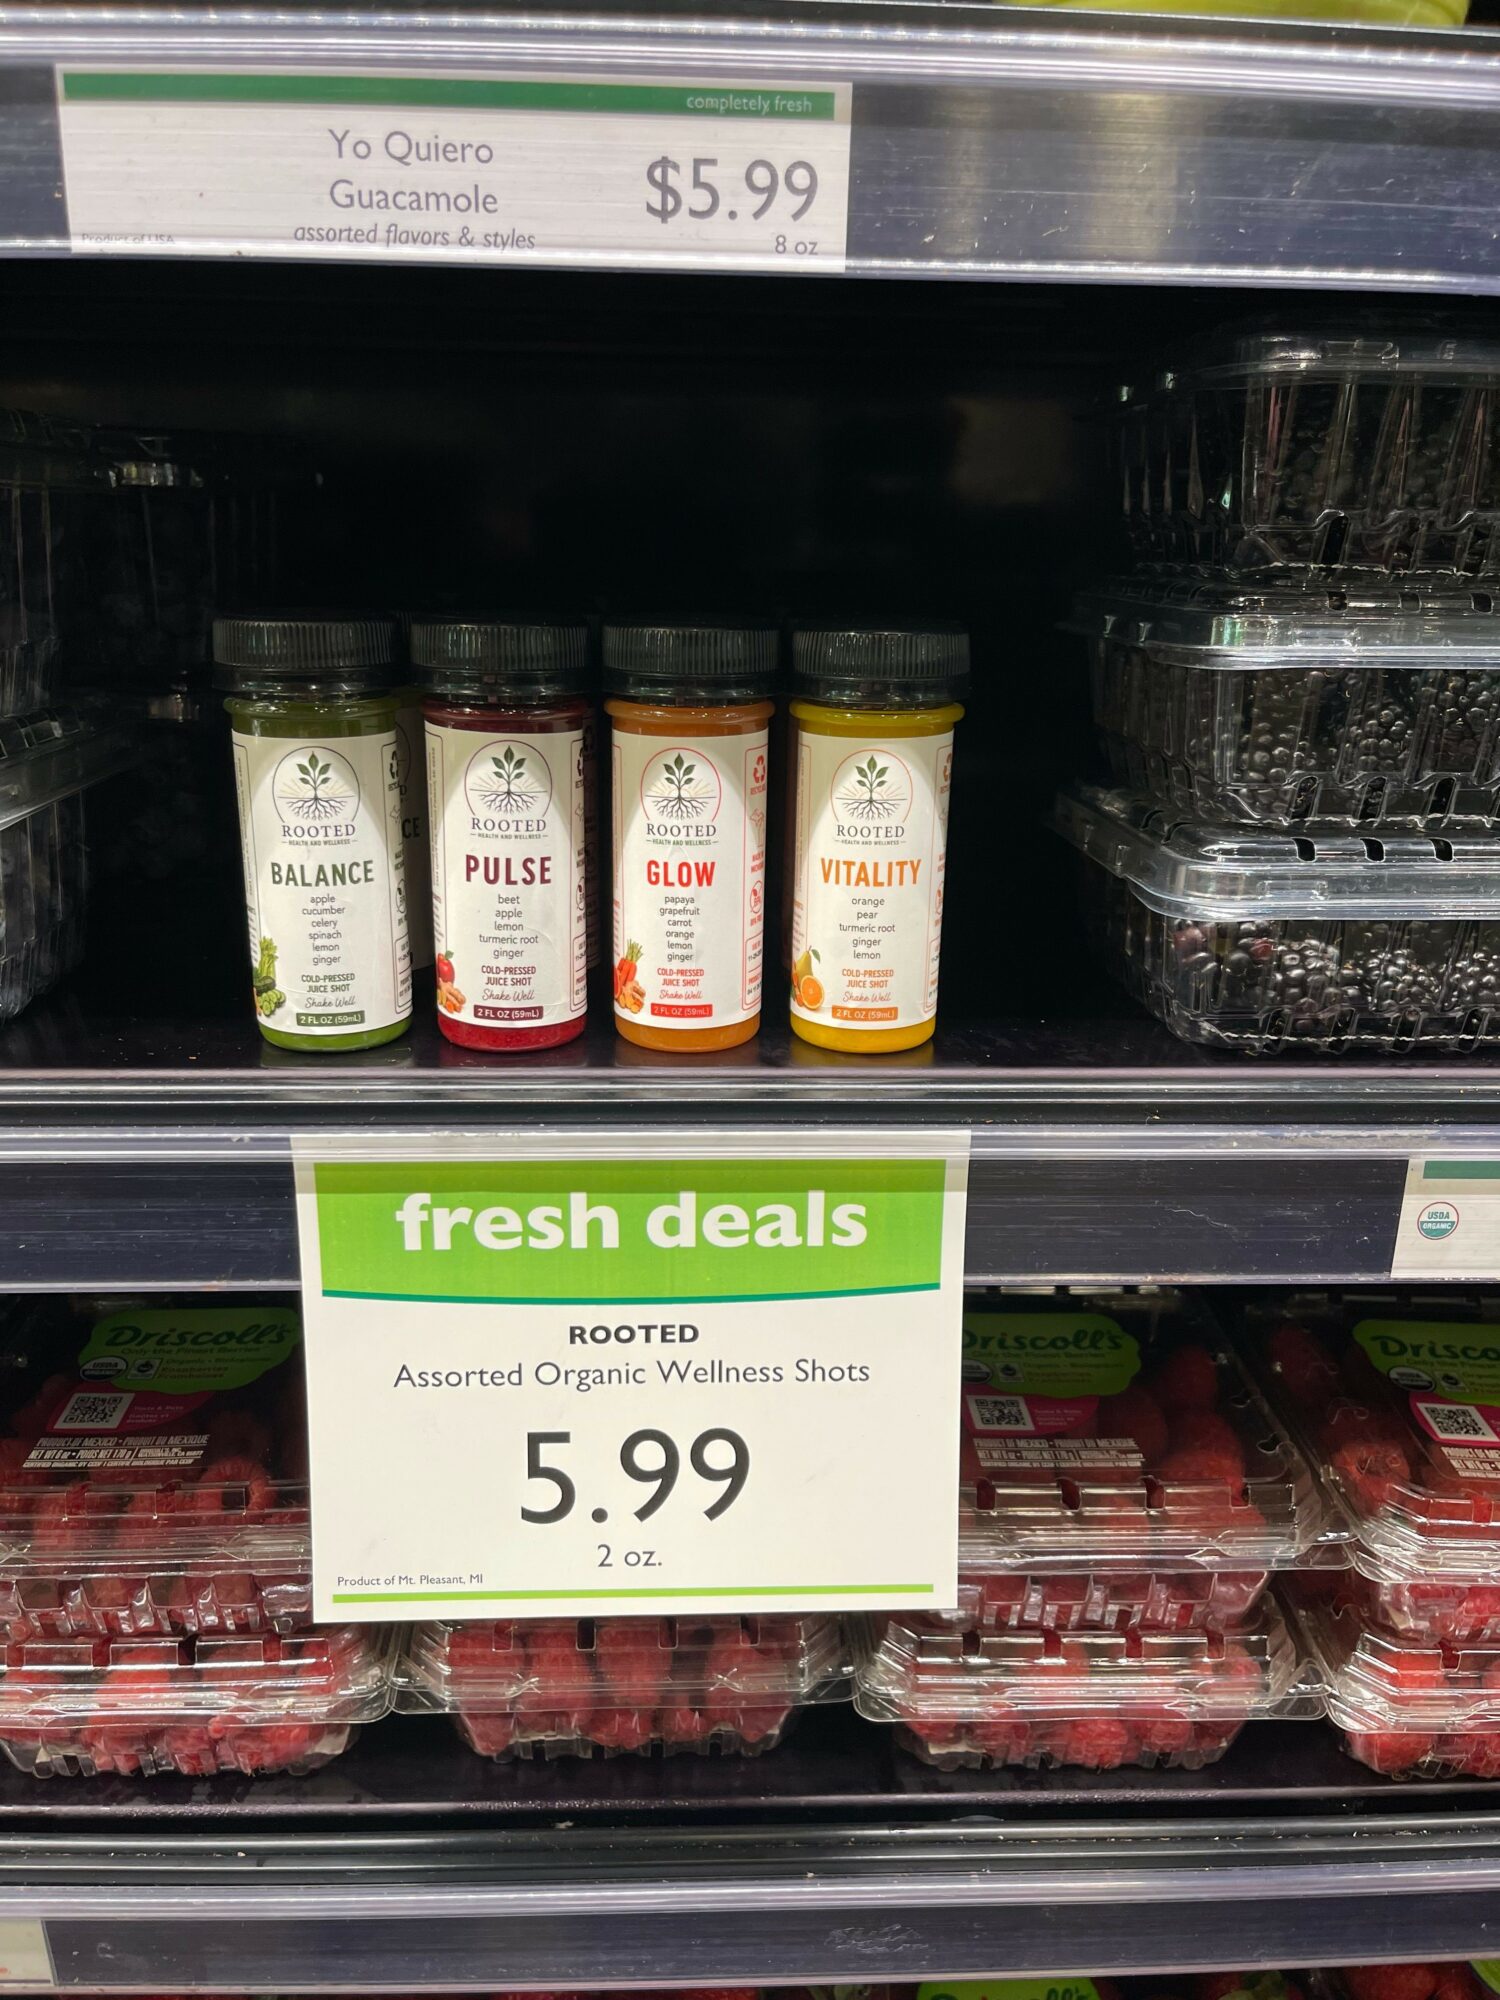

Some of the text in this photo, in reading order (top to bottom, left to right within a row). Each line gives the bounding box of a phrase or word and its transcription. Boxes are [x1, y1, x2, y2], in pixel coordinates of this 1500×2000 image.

[686, 95, 812, 114] completely fresh
[328, 129, 493, 166] Yo Quiero
[646, 155, 819, 223] $5.99
[330, 179, 498, 213] Guacamole
[294, 223, 536, 252] assorted flavors & styles
[774, 235, 819, 256] 8 oz
[471, 817, 547, 832] ROOTED
[646, 823, 717, 837] ROOTED
[281, 824, 356, 838] ROOTED
[836, 824, 905, 838] ROOTED
[310, 839, 321, 847] AND
[323, 838, 351, 846] WELLNESS
[652, 838, 671, 846] HEALTH
[270, 859, 375, 887] BALANCE
[465, 854, 552, 885] PULSE
[647, 859, 716, 888] GLOW
[820, 857, 922, 887] VITALITY
[310, 893, 336, 906] apple
[498, 893, 520, 905] beet
[664, 896, 695, 905] papaya
[851, 898, 885, 908] orange
[302, 905, 345, 916] cucumber
[495, 908, 523, 920] apple
[659, 906, 700, 917] grapefruit
[856, 911, 878, 921] pear
[311, 918, 338, 930] celery
[494, 920, 524, 931] lemon
[667, 918, 692, 927] carrot
[839, 922, 896, 933] turmeric root
[308, 930, 342, 941] spinach
[479, 934, 539, 945] turmeric root
[665, 929, 695, 940] orange
[312, 943, 340, 952] lemon
[667, 941, 693, 950] lemon
[852, 936, 882, 948] ginger
[493, 947, 524, 960] ginger
[667, 951, 694, 962] ginger
[853, 950, 881, 960] lemon
[312, 955, 341, 966] ginger
[481, 965, 537, 975] COLD-PRESSED
[657, 967, 705, 977] COLD-PRESSED
[841, 968, 894, 978] COLD-PRESSED
[301, 972, 355, 983] COLD-PRESSED
[485, 977, 532, 986] JUICE SHOT
[662, 978, 700, 987] JUICE SHOT
[306, 983, 351, 993] JUICE SHOT
[846, 980, 889, 989] JUICE SHOT
[482, 988, 535, 1001] Shake Well
[659, 989, 703, 1000] Shake Well
[842, 991, 892, 1003] Shake Well
[305, 996, 356, 1009] Shake Well
[477, 1008, 540, 1019] 2 FL OZ (59mL)
[653, 1006, 710, 1016] 2 FL OZ (59mL)
[836, 1009, 895, 1020] 2 FL OZ (59mL)
[300, 1013, 362, 1025] 2 FL OZ (59mL)
[395, 1189, 868, 1250] fresh deals
[1427, 1211, 1450, 1220] USDA
[1422, 1222, 1452, 1230] ORGANIC
[105, 1324, 292, 1347] Driscoll's
[568, 1324, 700, 1346] ROOTED
[393, 1358, 871, 1393] Assorted Organic Wellness Shots
[520, 1428, 751, 1525] 5.99
[597, 1543, 663, 1569] 2 oz.
[337, 1573, 483, 1587] Product of Mt. Pleasant, MI
